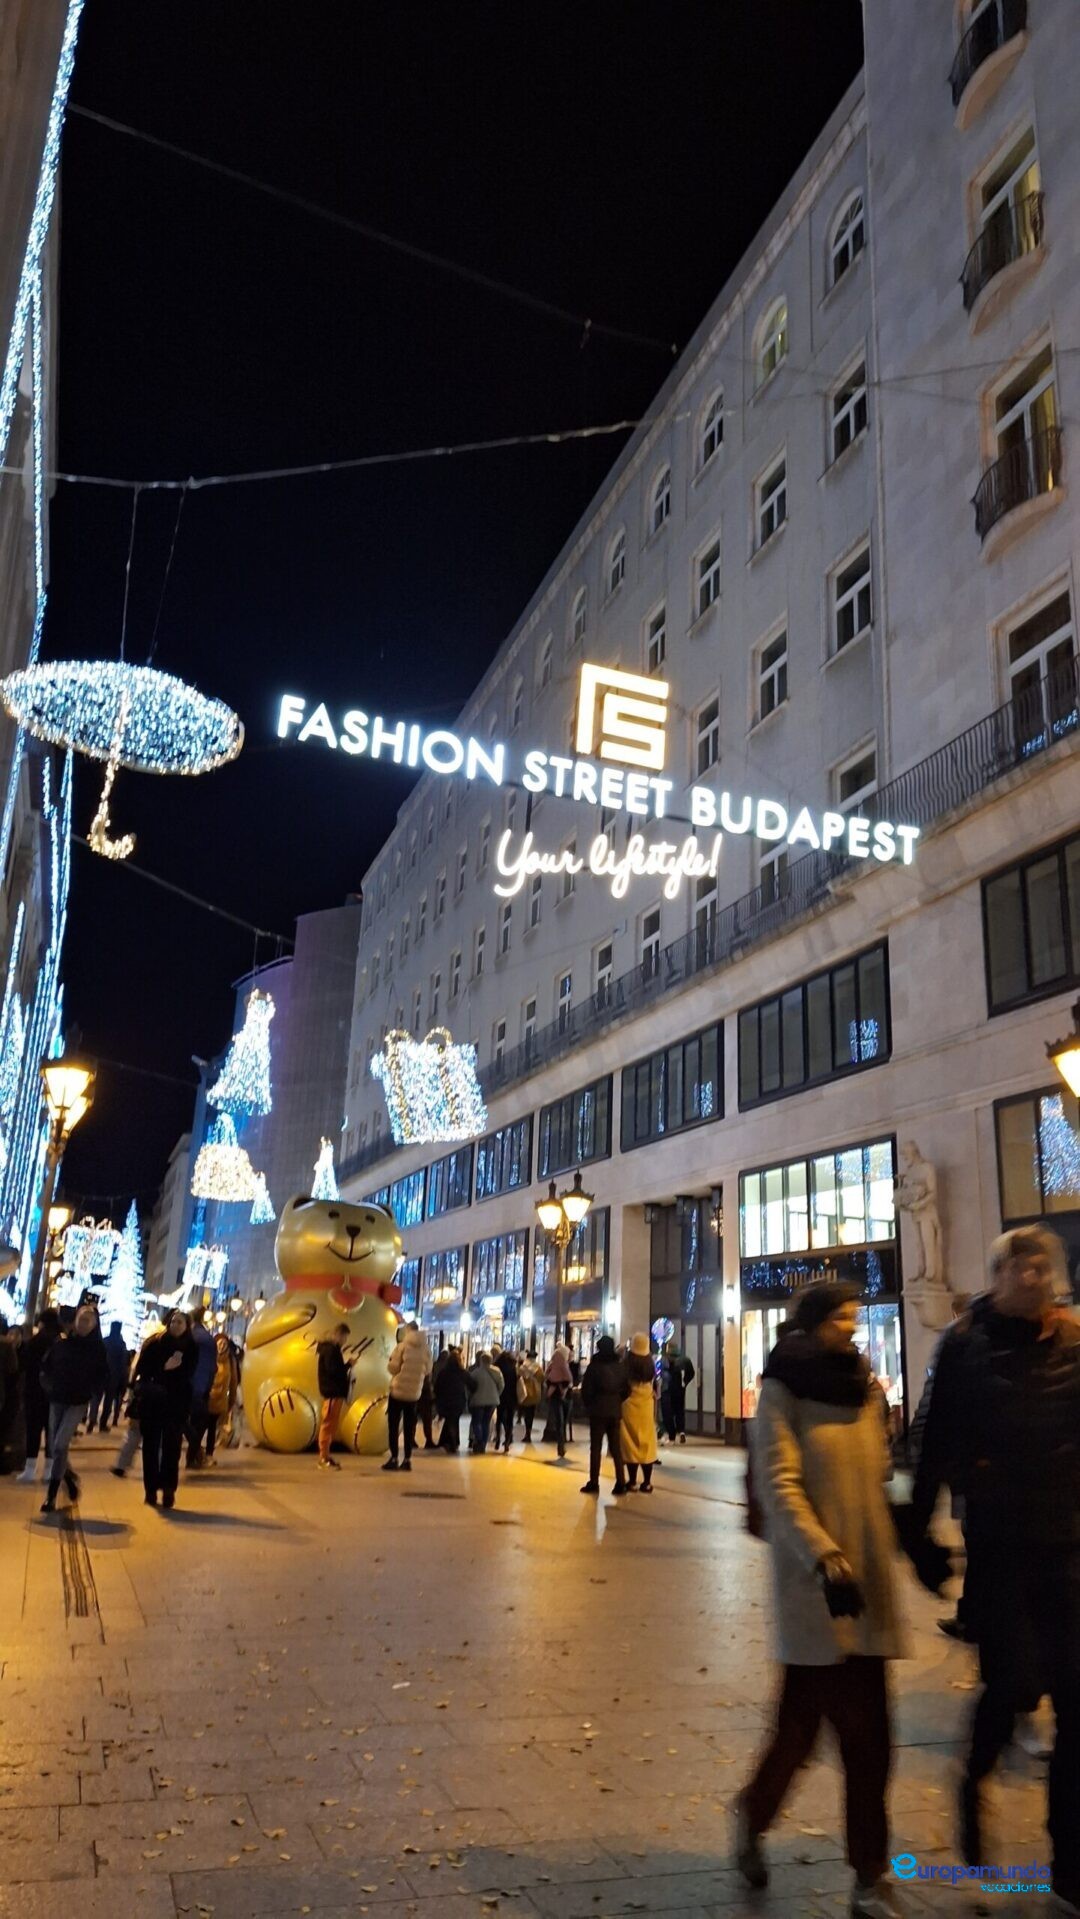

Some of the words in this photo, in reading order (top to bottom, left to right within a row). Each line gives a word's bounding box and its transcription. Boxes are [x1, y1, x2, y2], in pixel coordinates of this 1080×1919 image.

[276, 694, 505, 785] FASHION
[522, 751, 673, 819] STREET
[691, 787, 921, 866] BUDAPEST
[494, 829, 583, 897] Your
[589, 832, 723, 900] lifestyle!
